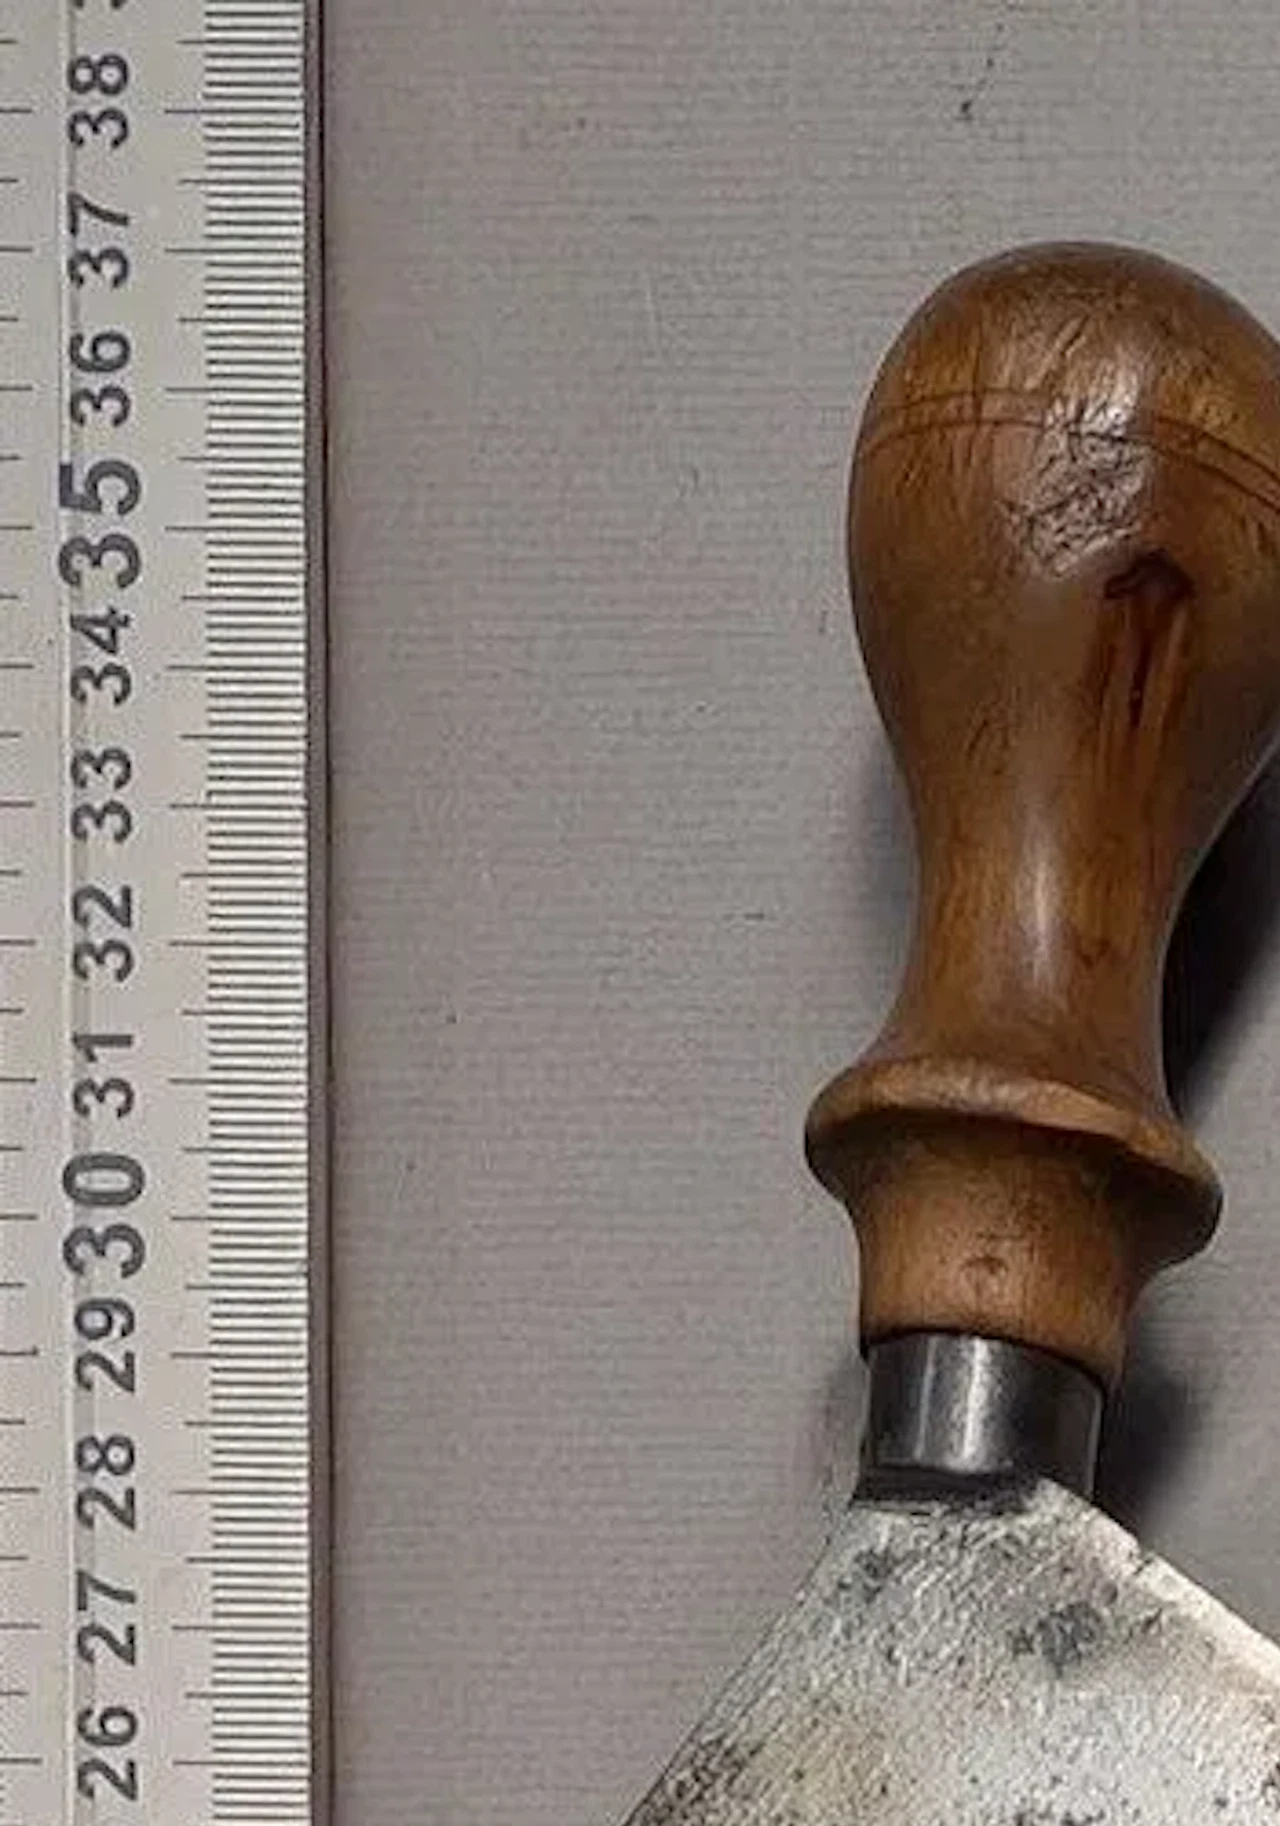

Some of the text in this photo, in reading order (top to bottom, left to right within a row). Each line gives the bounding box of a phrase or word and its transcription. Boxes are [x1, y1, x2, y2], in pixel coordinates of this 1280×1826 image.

[66, 54, 130, 150] 38
[67, 191, 130, 290] 37
[68, 331, 131, 428] 36
[57, 460, 142, 590] 35
[69, 606, 132, 706] 34
[70, 747, 133, 844] 33
[71, 885, 134, 983] 32
[70, 1031, 135, 1120] 31
[61, 1152, 146, 1279] 30
[73, 1298, 136, 1394] 29
[74, 1435, 136, 1531] 28
[75, 1568, 137, 1667] 27
[76, 1706, 138, 1802] 26
